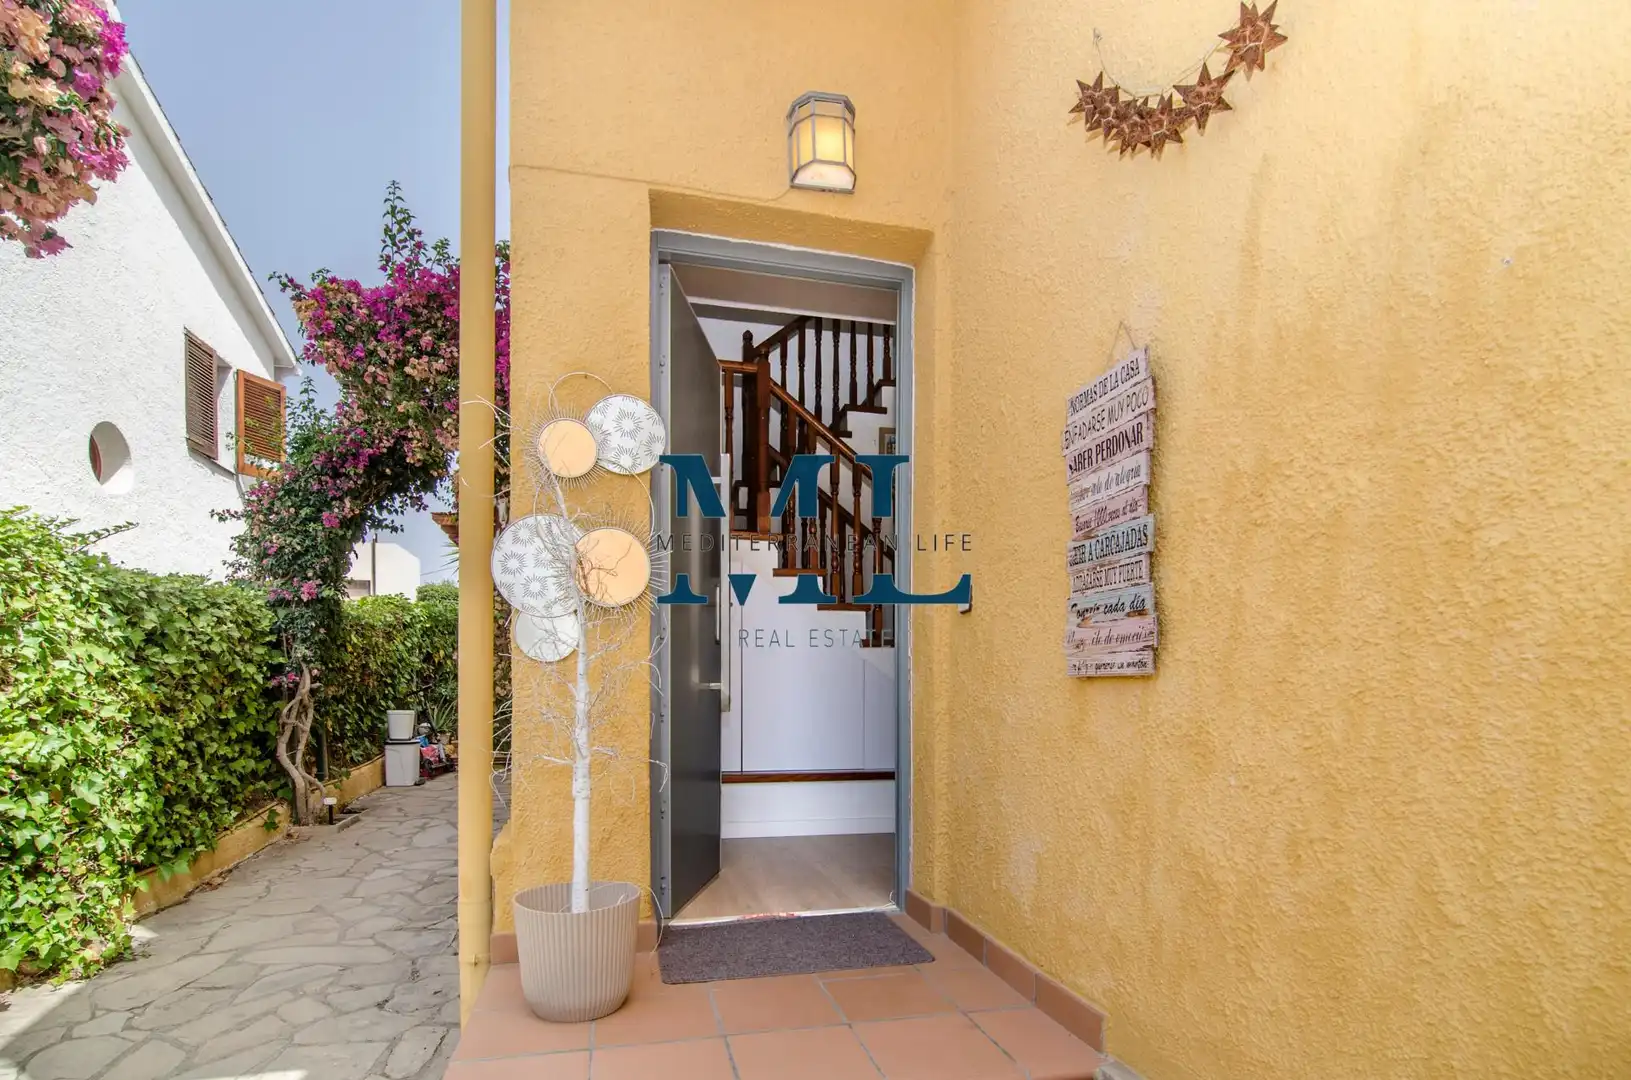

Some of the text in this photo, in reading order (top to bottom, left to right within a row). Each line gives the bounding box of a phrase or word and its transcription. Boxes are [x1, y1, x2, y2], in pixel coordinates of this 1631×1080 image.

[1069, 357, 1140, 416] NORMAS DE LA CASA
[1064, 384, 1149, 450] ENFADARSE MUY POCO
[1095, 422, 1143, 464] PERDONAR
[1088, 541, 1093, 562] A
[1095, 524, 1149, 560] CARCAJADAS
[1118, 560, 1143, 583] FUERTE
[1103, 597, 1126, 615] cada
[1129, 593, 1146, 610] día
